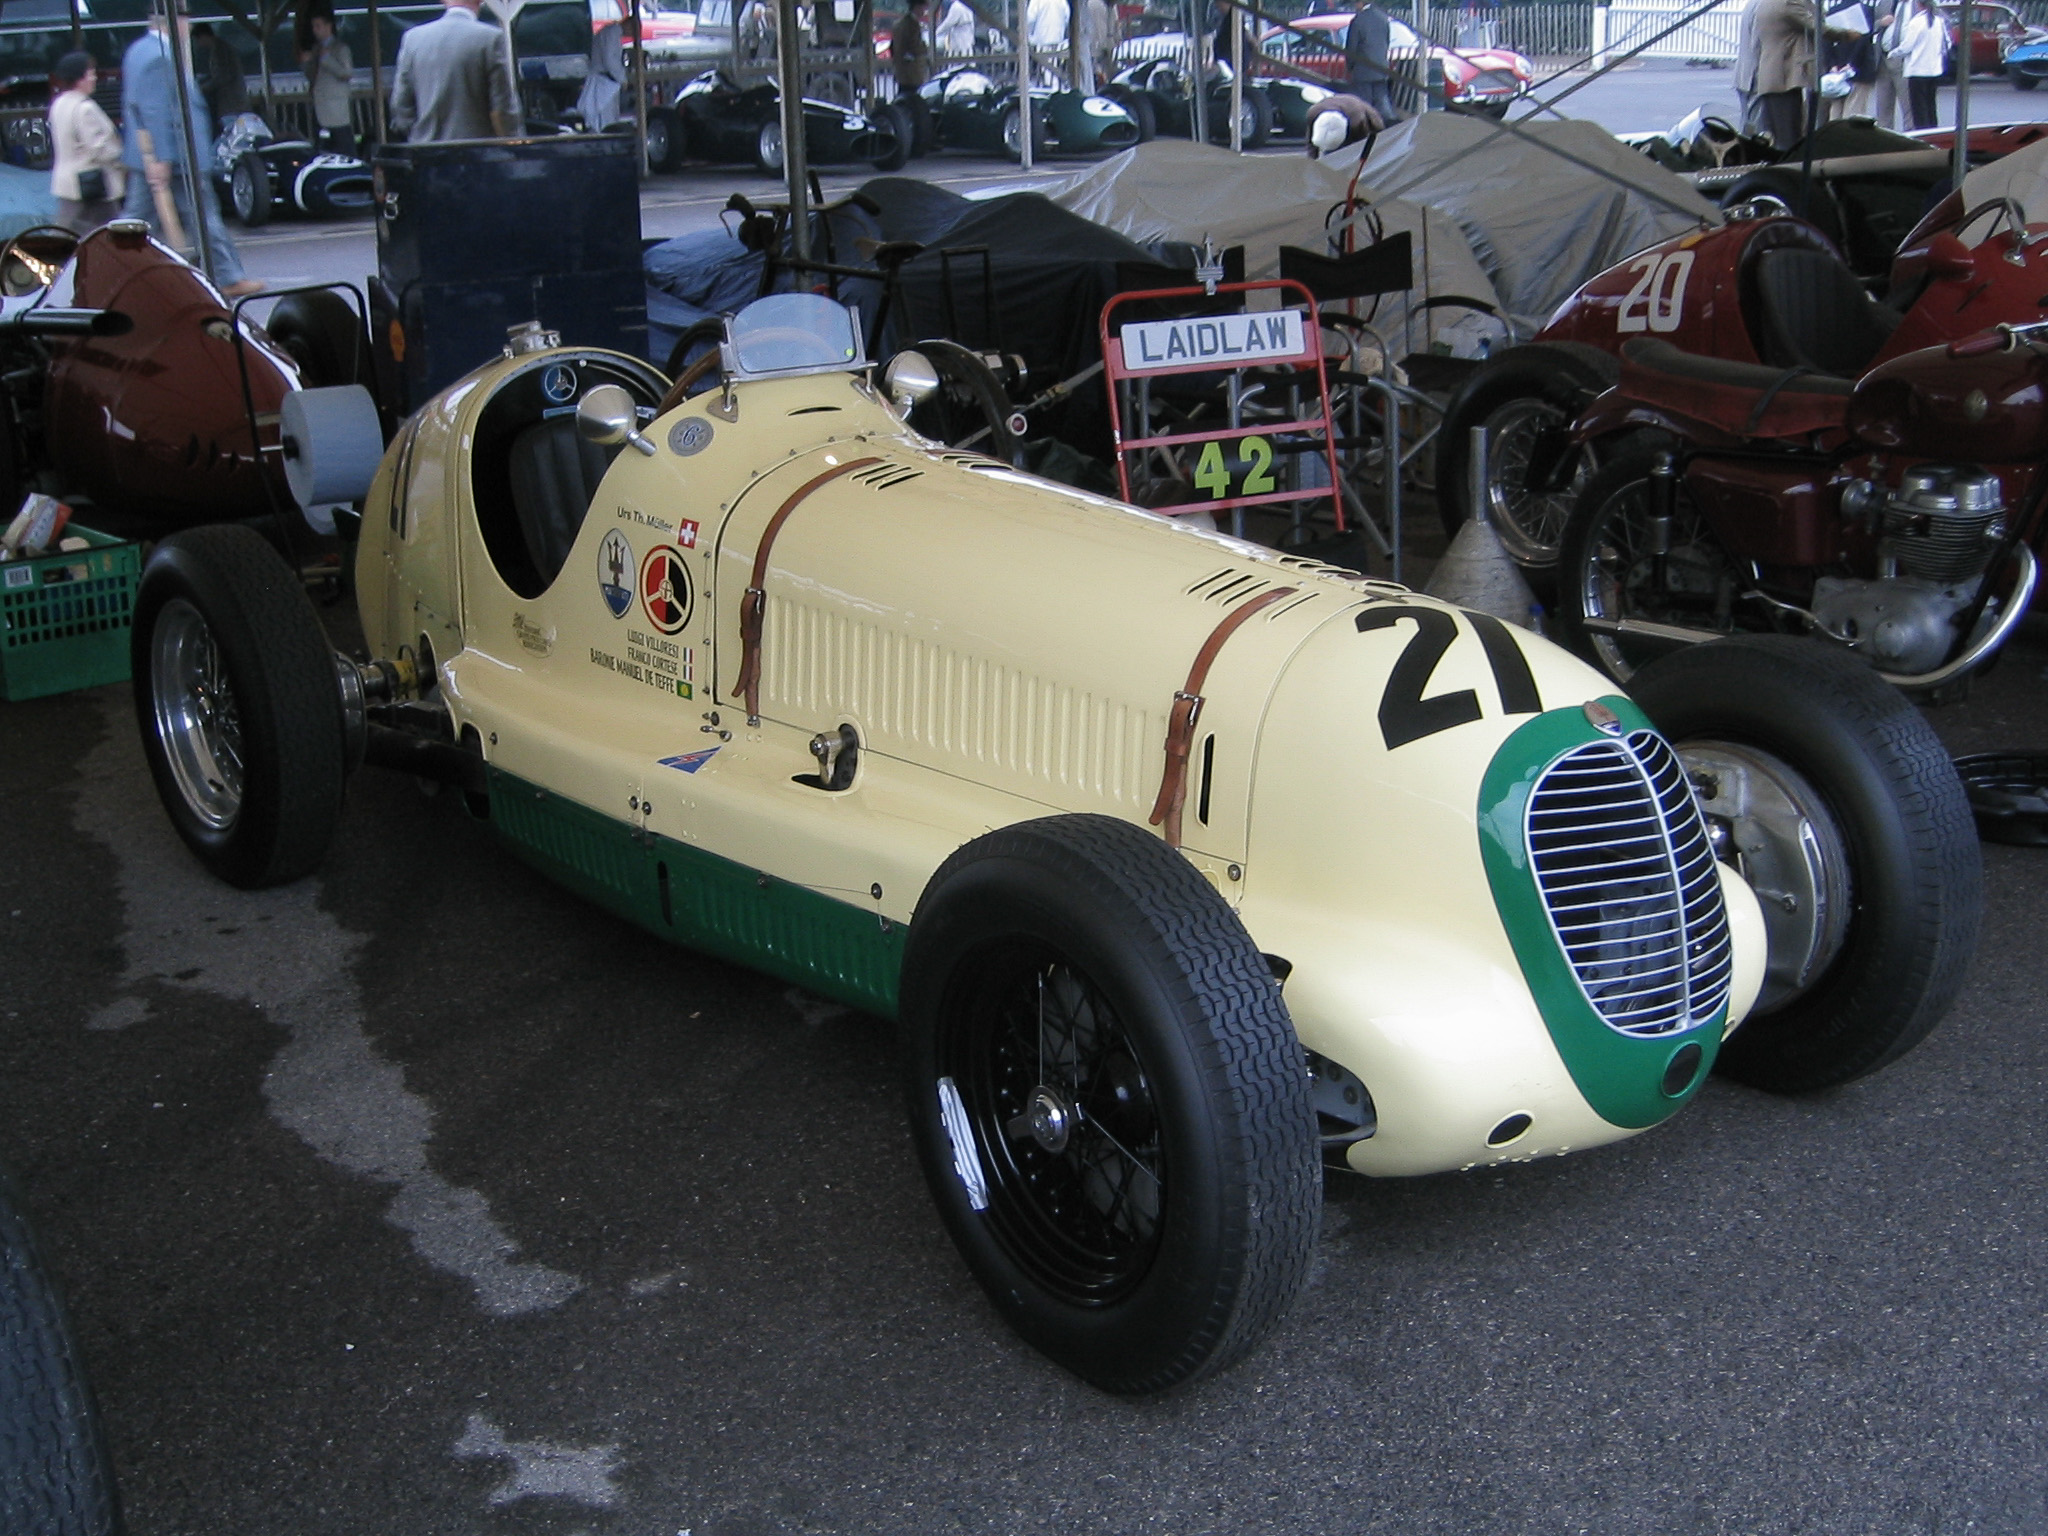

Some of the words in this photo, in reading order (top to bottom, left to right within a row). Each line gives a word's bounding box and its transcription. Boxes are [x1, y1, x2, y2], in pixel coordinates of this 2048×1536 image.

[1616, 250, 1696, 333] 20
[1139, 316, 1288, 363] LAIDLAW
[1194, 435, 1276, 499] 42
[617, 506, 632, 521] Urs
[645, 668, 654, 686] DE
[655, 672, 675, 694] TEFFE
[1355, 606, 1544, 751] 21
